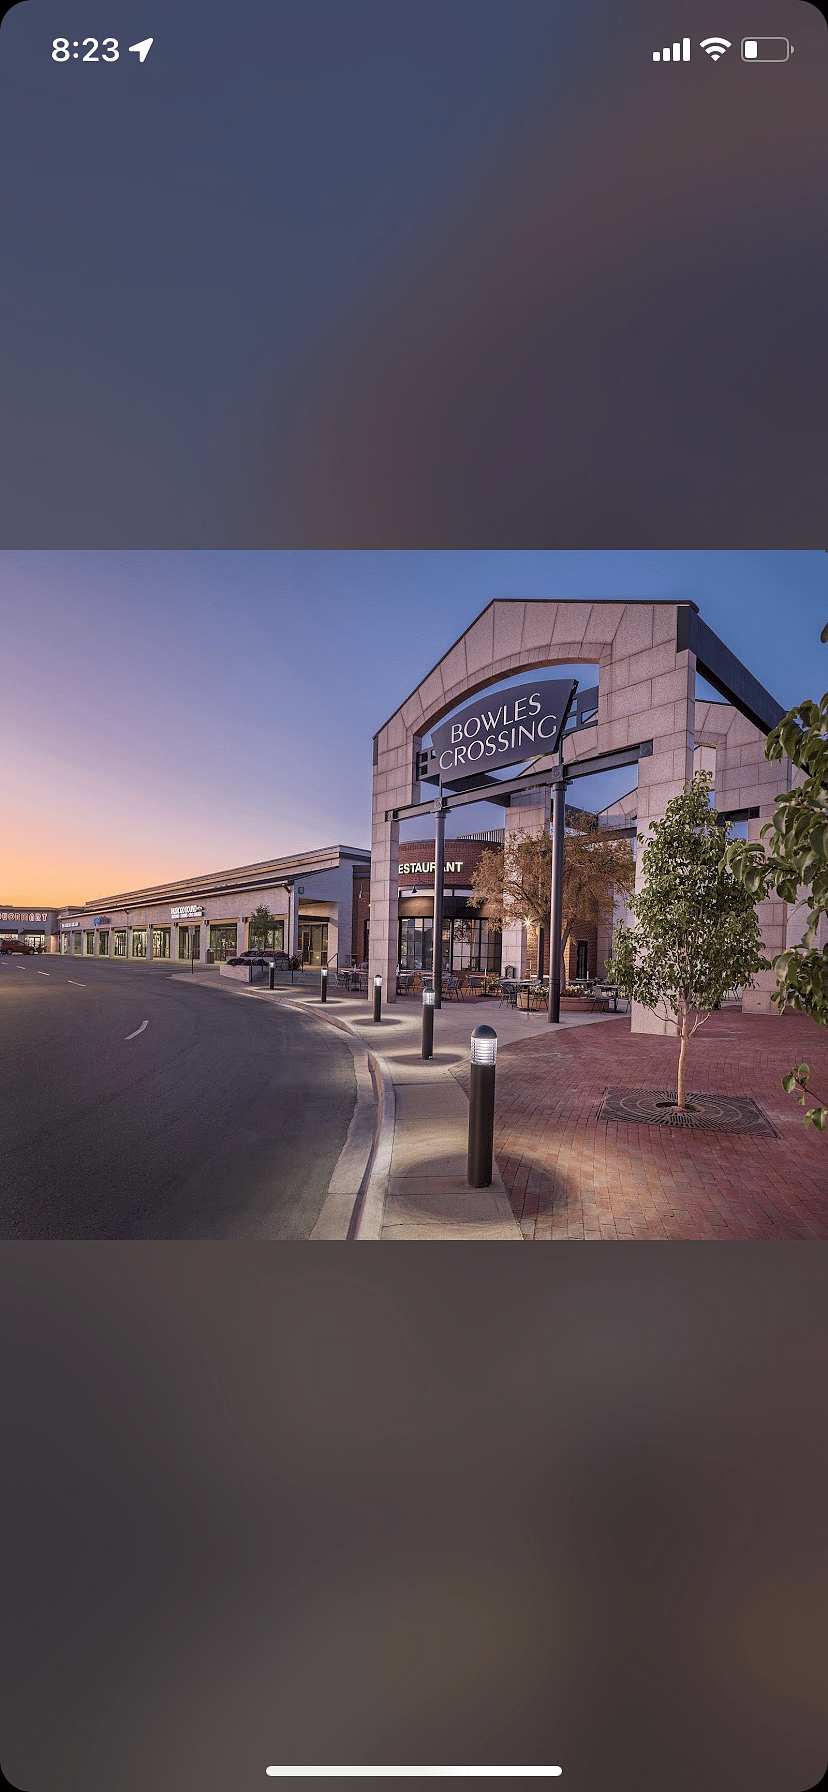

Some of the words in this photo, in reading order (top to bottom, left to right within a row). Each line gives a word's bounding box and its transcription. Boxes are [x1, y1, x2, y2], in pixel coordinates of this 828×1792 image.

[439, 714, 557, 770] CROSSING
[451, 692, 542, 744] BOWLES
[398, 861, 464, 874] ESTAURNT
